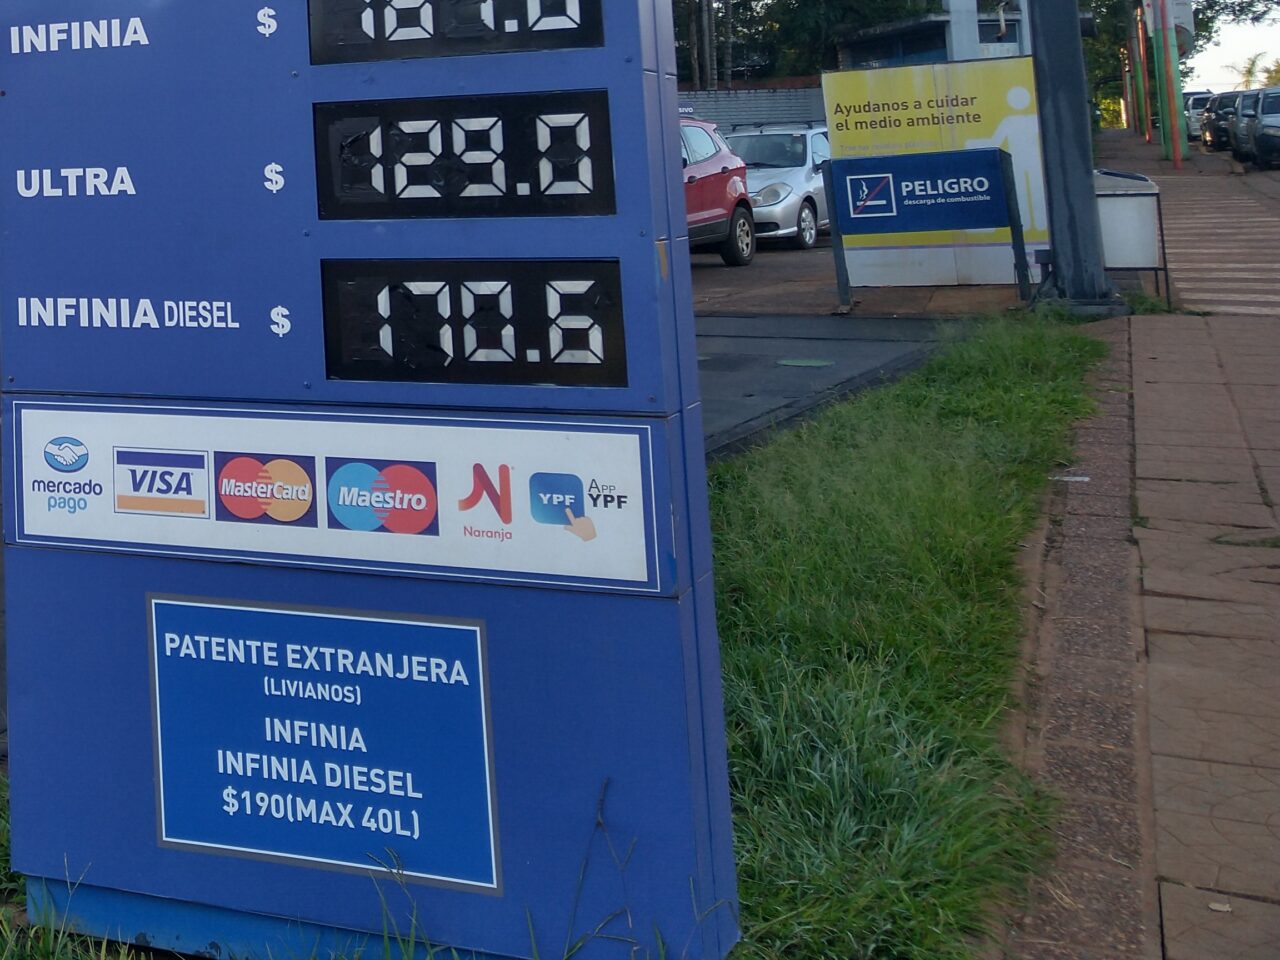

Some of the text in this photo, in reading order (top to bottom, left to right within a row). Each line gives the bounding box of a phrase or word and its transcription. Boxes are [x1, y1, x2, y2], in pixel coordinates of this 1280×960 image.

[10, 16, 149, 54] INFINIA
[256, 6, 278, 38] $
[834, 95, 977, 117] Ayudanos a cuidar
[835, 112, 981, 131] el medio ambiente
[16, 166, 136, 198] ULTRA
[263, 161, 285, 193] $
[369, 113, 593, 198] 129.0
[901, 176, 989, 196] PELIGRO
[904, 198, 935, 206] descarga
[946, 194, 990, 203] combustible
[18, 280, 604, 366] INFINIA DIESEL $ 170.6
[32, 478, 103, 496] mercado
[128, 469, 194, 495] VISA
[221, 478, 309, 501] MasterCard
[47, 495, 87, 514] pago
[338, 486, 427, 511] Maestro
[538, 493, 576, 506] YPF
[588, 493, 628, 510] YPF
[463, 525, 513, 542] Naranja
[165, 633, 469, 685] PATENTE EXTRANJERA
[264, 676, 362, 705] (LIVIANOS)
[265, 717, 367, 752] INFINIA
[217, 750, 423, 799] INFINIA DIESEL
[361, 806, 420, 840] 40L)
